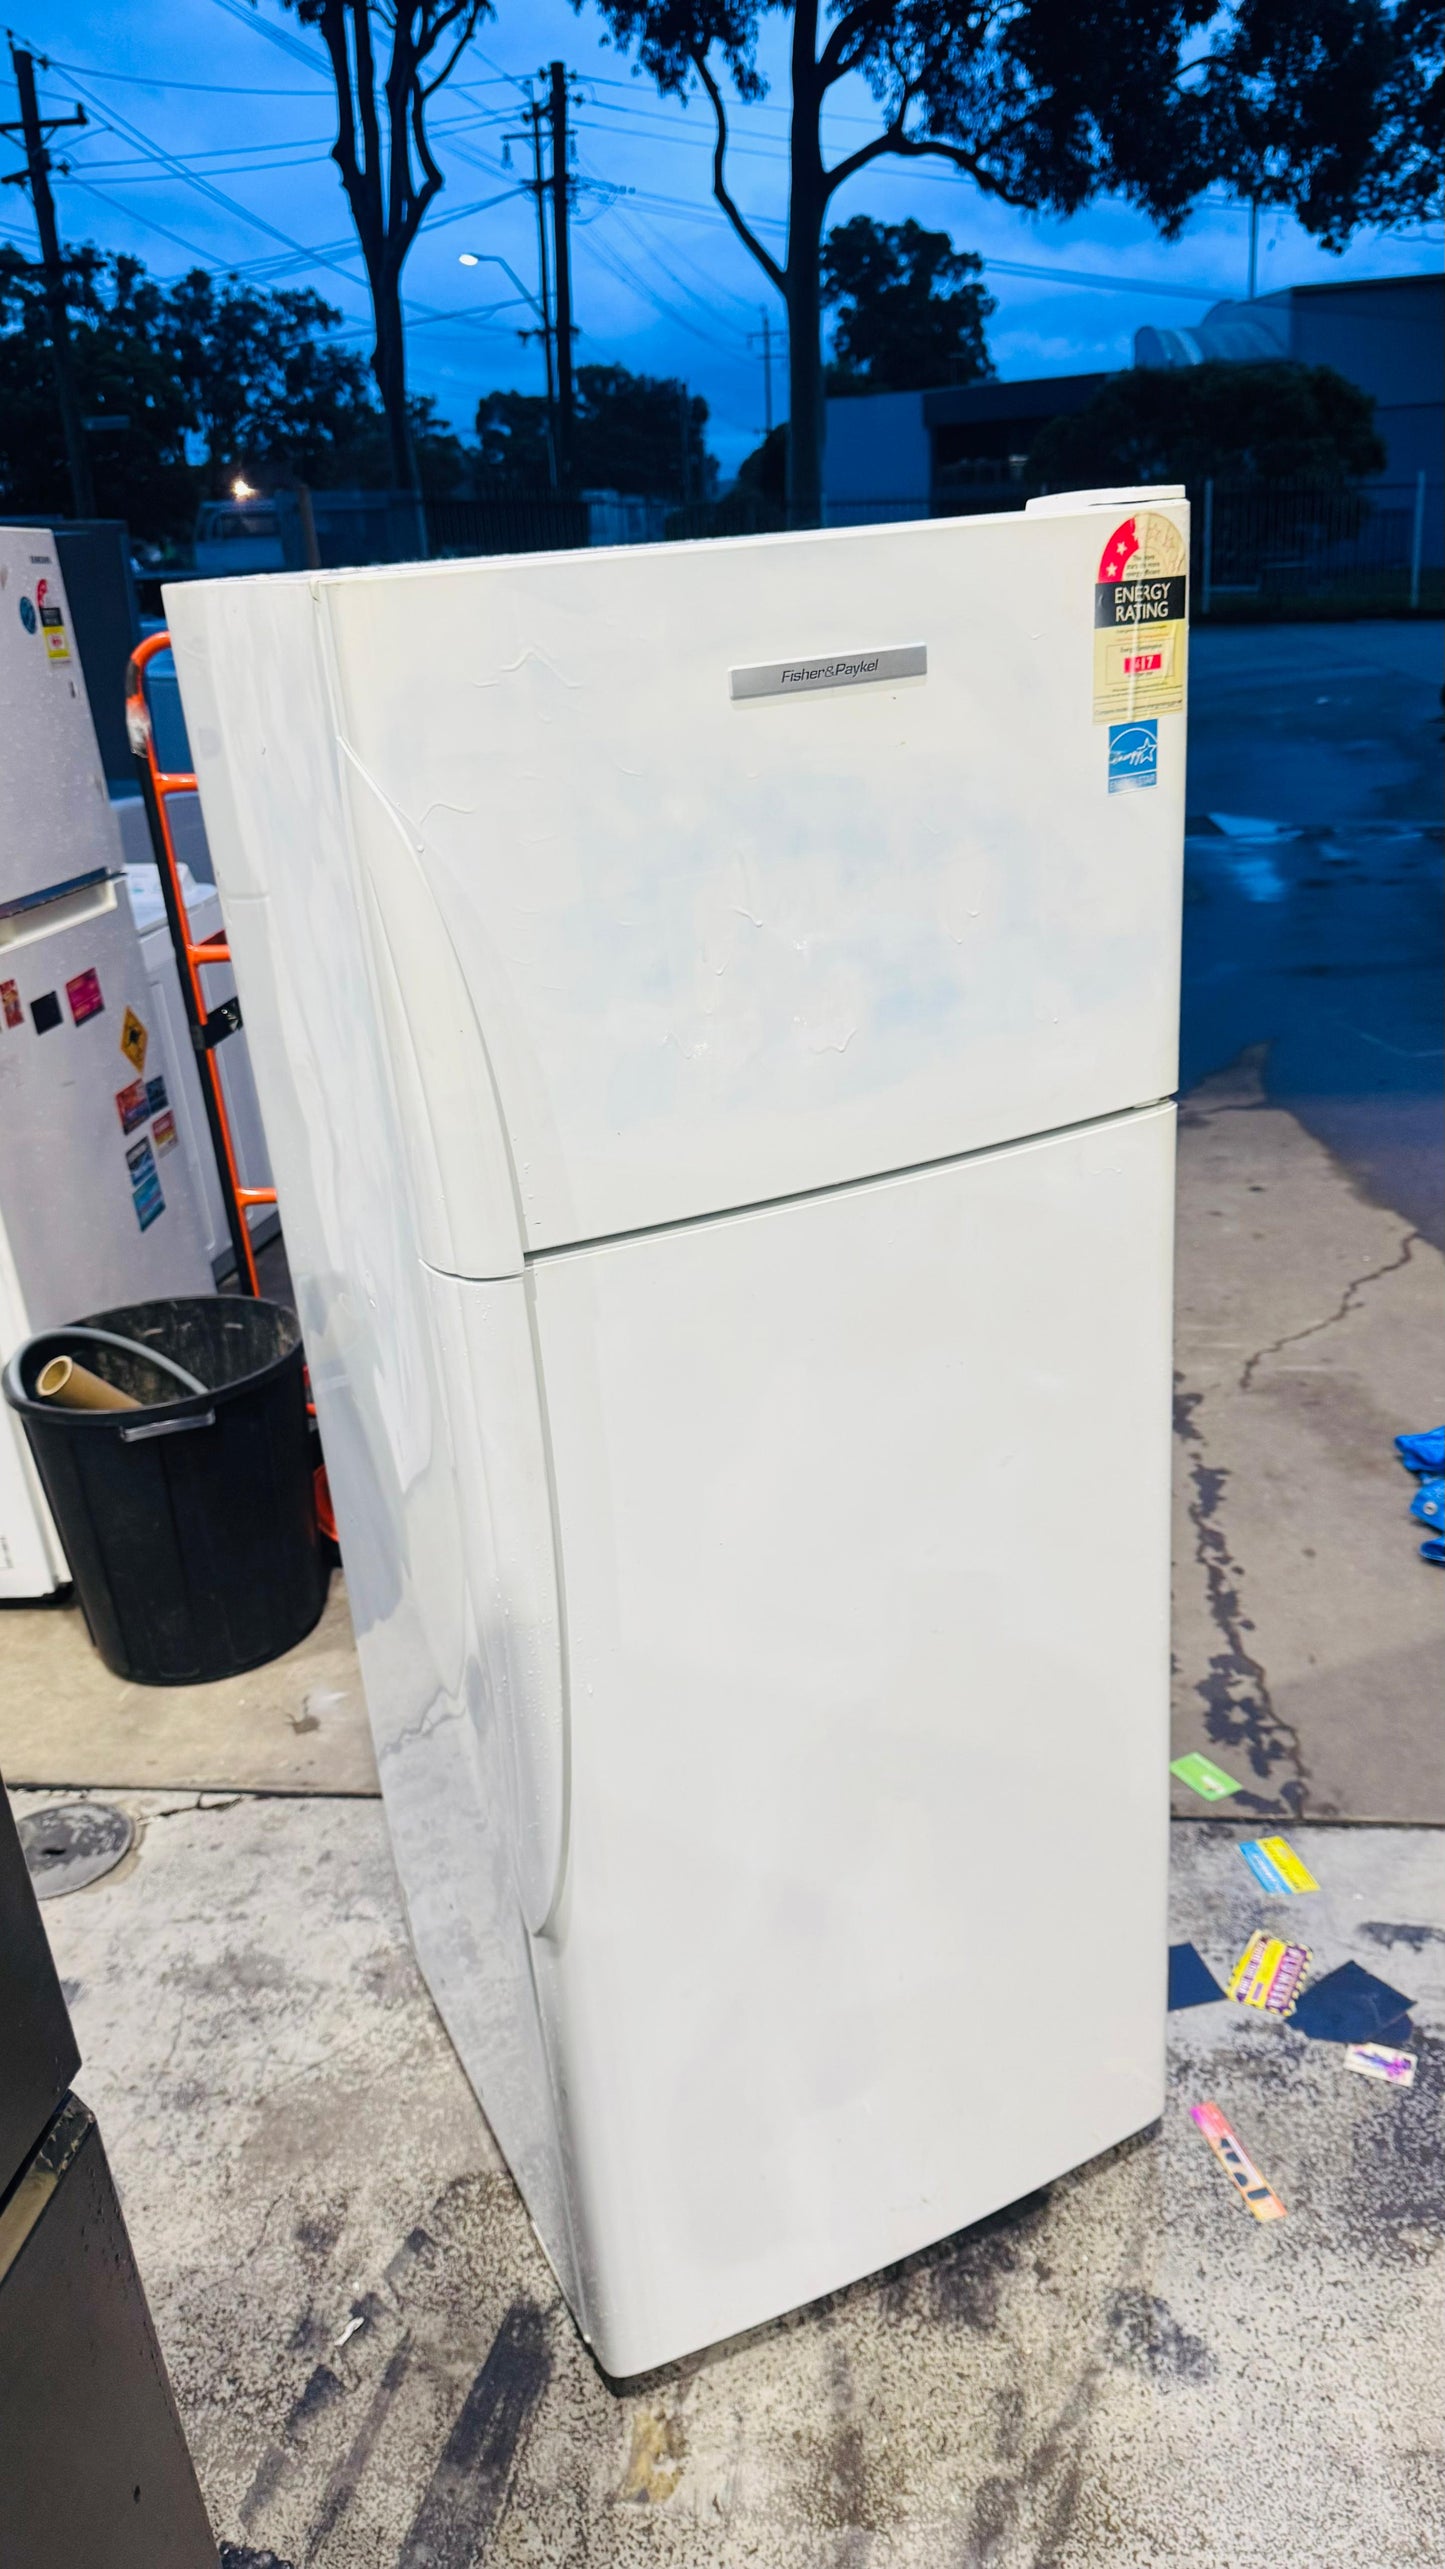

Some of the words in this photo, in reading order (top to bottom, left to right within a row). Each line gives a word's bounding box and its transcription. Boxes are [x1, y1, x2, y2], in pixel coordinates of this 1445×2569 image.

[1114, 583, 1171, 604] ENERGY
[1116, 602, 1169, 622] RATING
[781, 659, 879, 683] Fisher&Paykel
